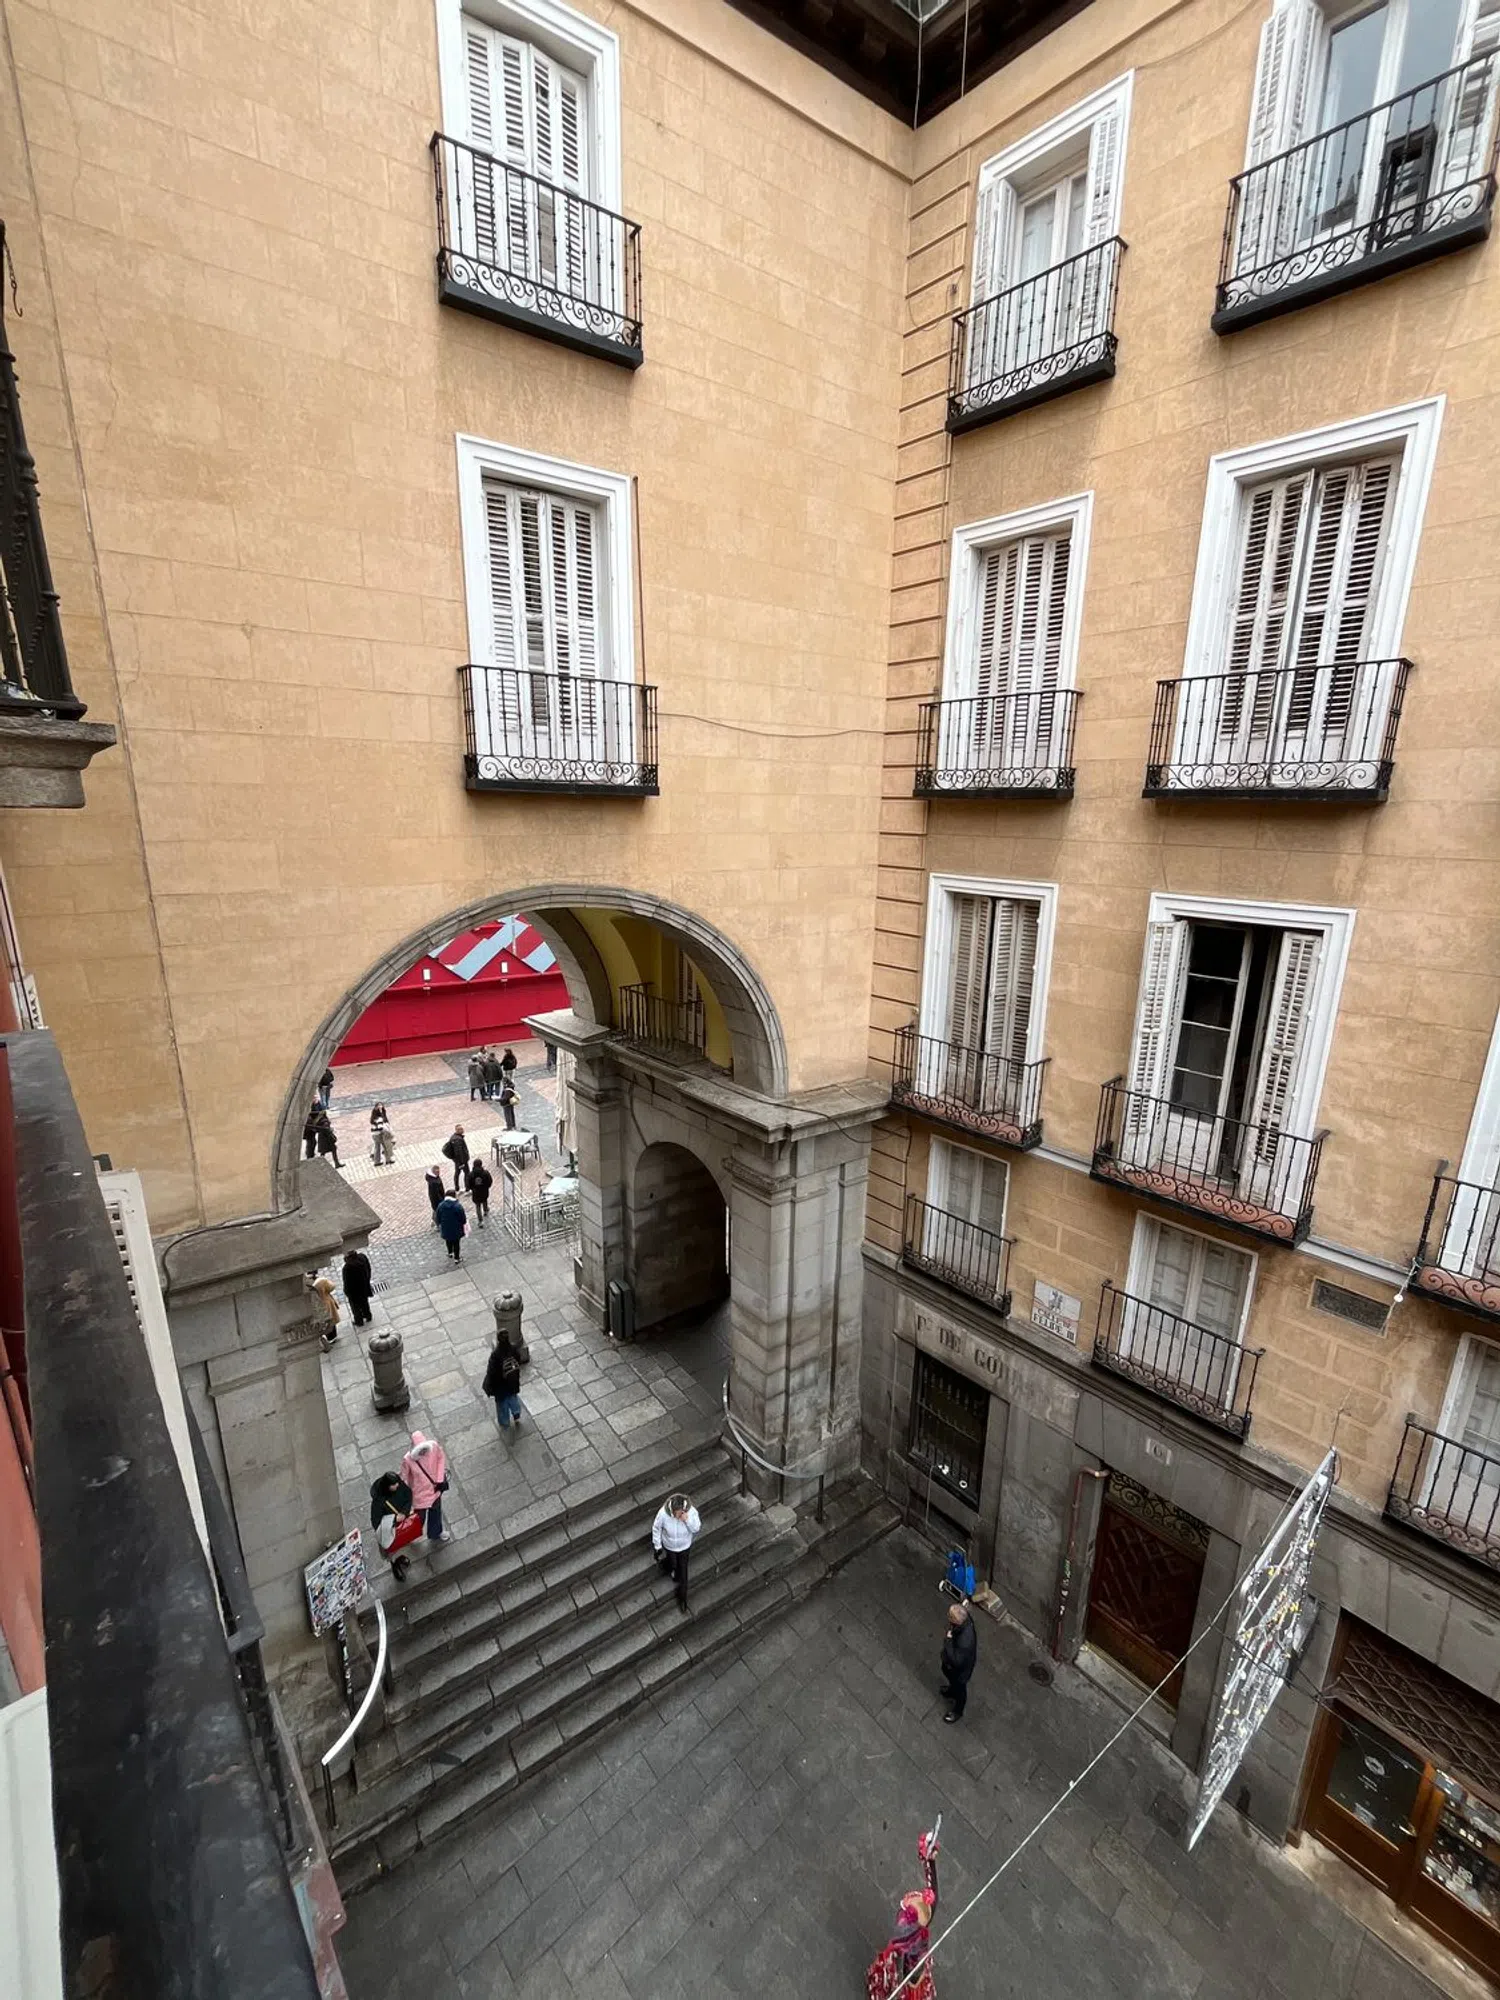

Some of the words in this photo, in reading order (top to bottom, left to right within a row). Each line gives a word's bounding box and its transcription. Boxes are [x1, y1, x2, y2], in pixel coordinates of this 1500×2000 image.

[940, 1327, 961, 1353] DE
[1033, 1313, 1064, 1336] FELIPE
[1066, 1330, 1075, 1341] III
